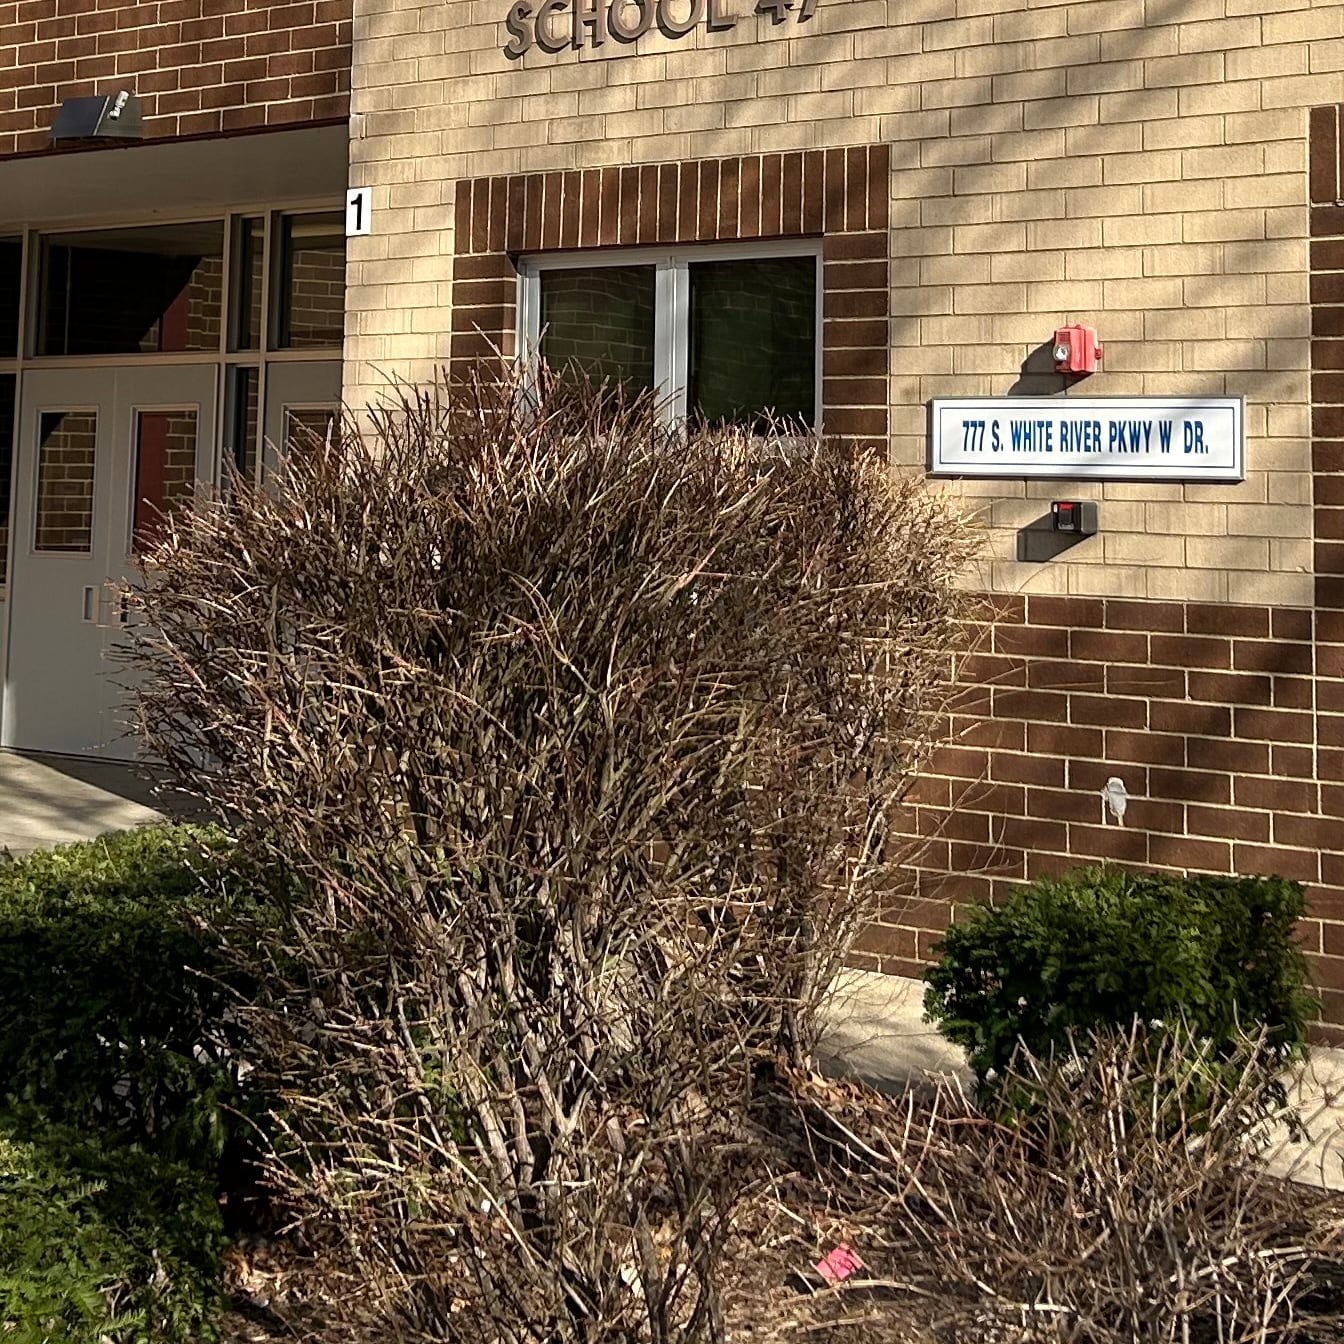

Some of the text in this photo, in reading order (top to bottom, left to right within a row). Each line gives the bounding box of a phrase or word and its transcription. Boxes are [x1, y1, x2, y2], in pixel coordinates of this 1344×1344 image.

[351, 193, 363, 230] 1
[962, 419, 1209, 455] 777 S. WHITE RIVER PKWY W DR.
